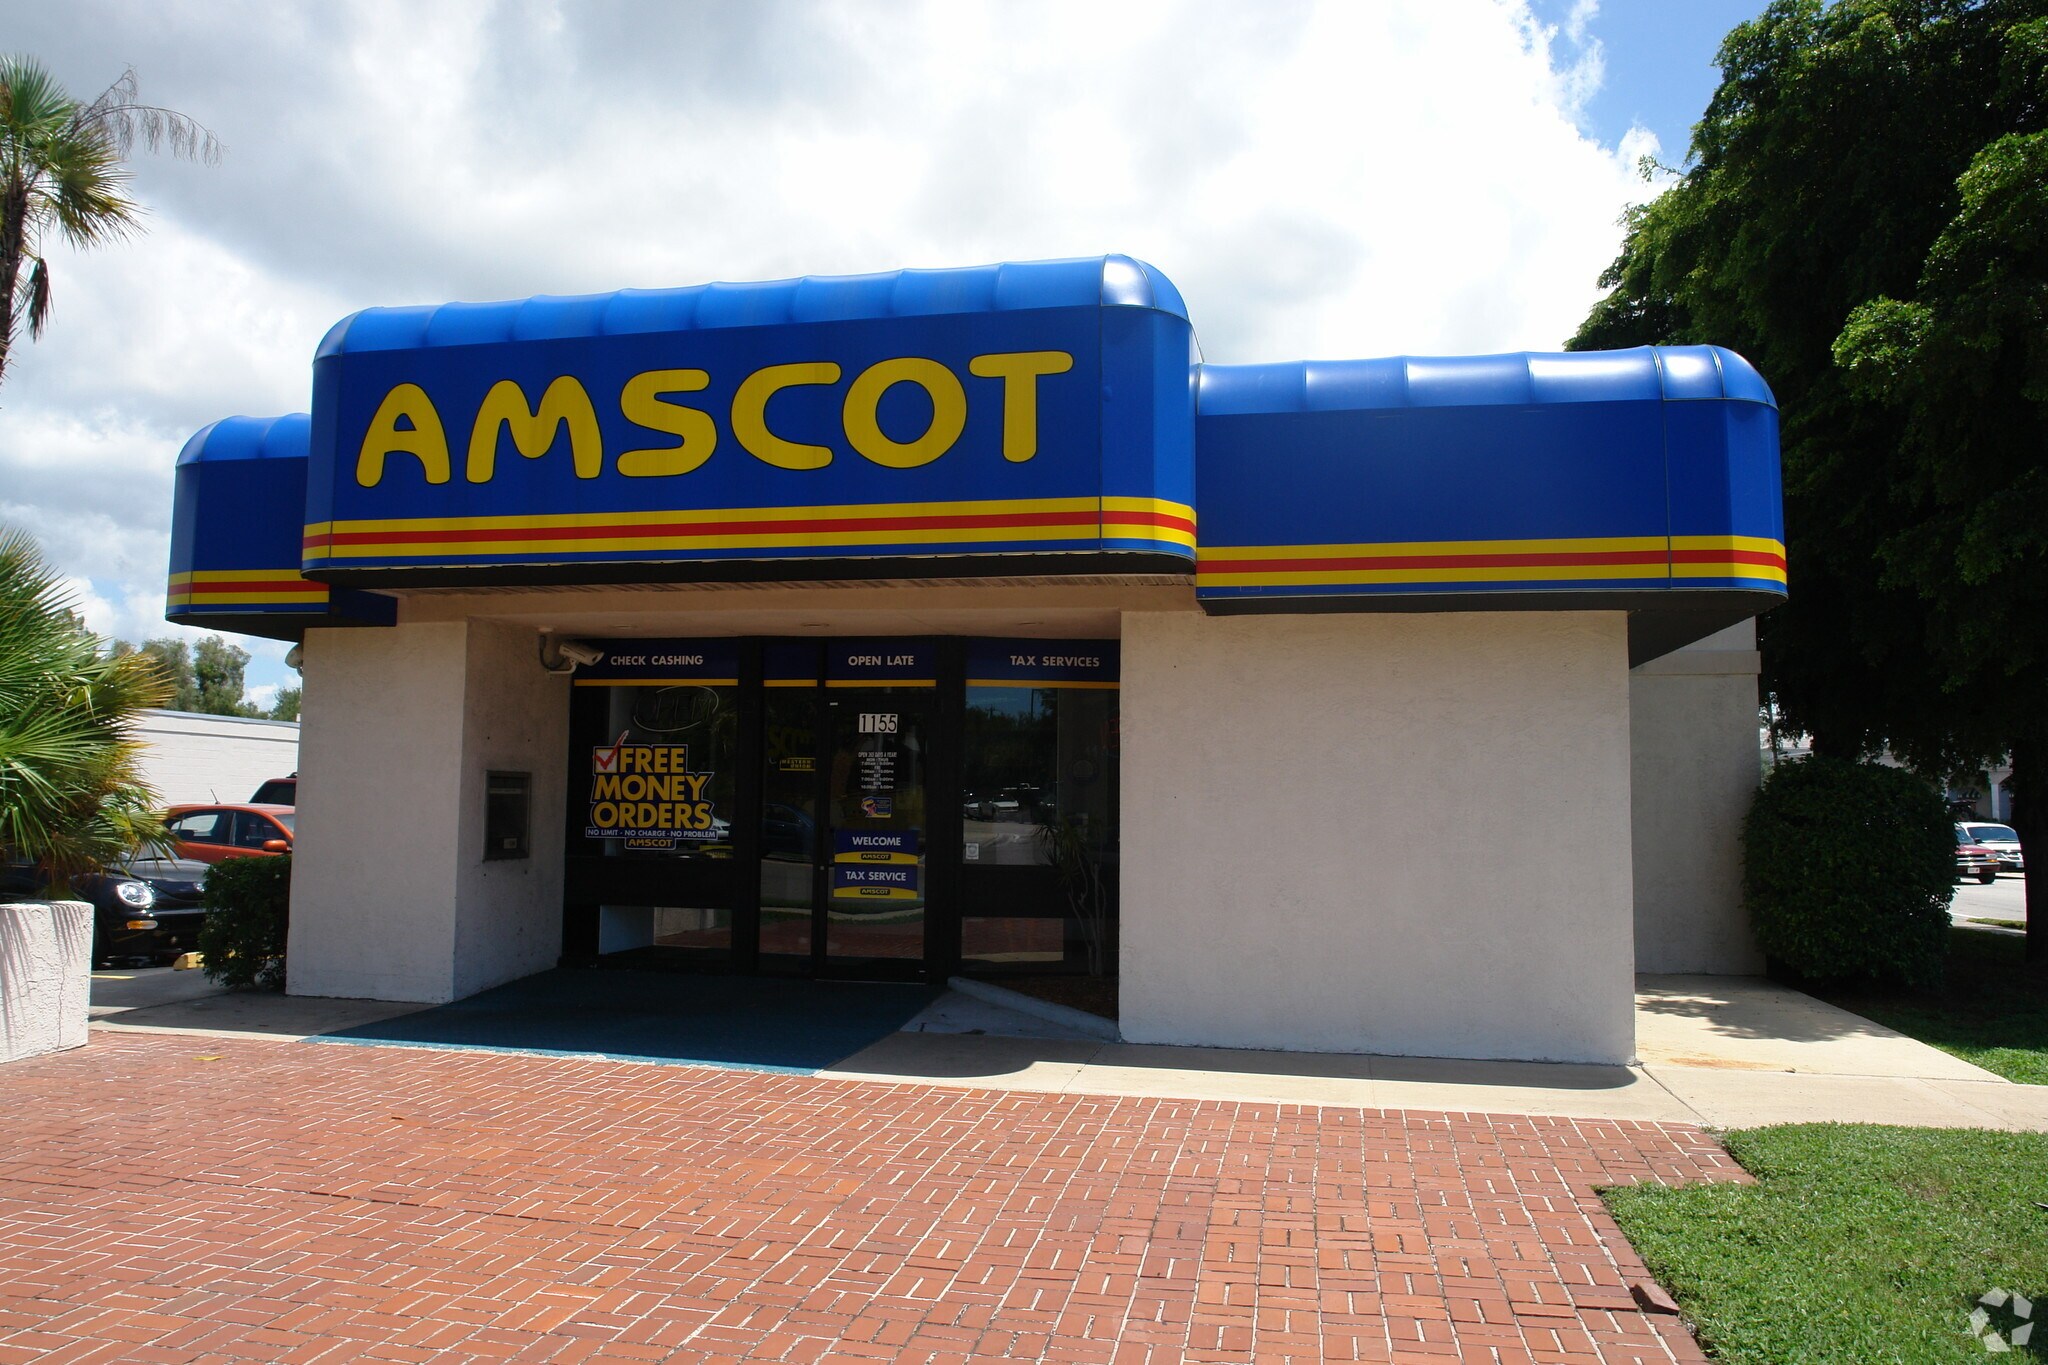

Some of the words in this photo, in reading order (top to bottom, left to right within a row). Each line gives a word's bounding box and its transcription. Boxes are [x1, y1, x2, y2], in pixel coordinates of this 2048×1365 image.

[356, 351, 1074, 488] AMSCOT
[610, 655, 646, 666] CHECK
[651, 655, 704, 666] CASHING
[847, 655, 881, 666] OPEN
[886, 655, 914, 666] LATE
[1010, 655, 1036, 666] TAX
[1042, 656, 1100, 668] SERVICES
[861, 714, 897, 732] 1155
[619, 747, 685, 774] FREE
[594, 774, 709, 801] MONEY
[593, 801, 712, 830] ORDERS
[624, 829, 636, 837] NO
[670, 830, 682, 838] NO
[628, 838, 673, 847] AMSCOT
[852, 836, 901, 846] WELCOME
[845, 871, 865, 880] TAX
[868, 871, 906, 881] SERVICE
